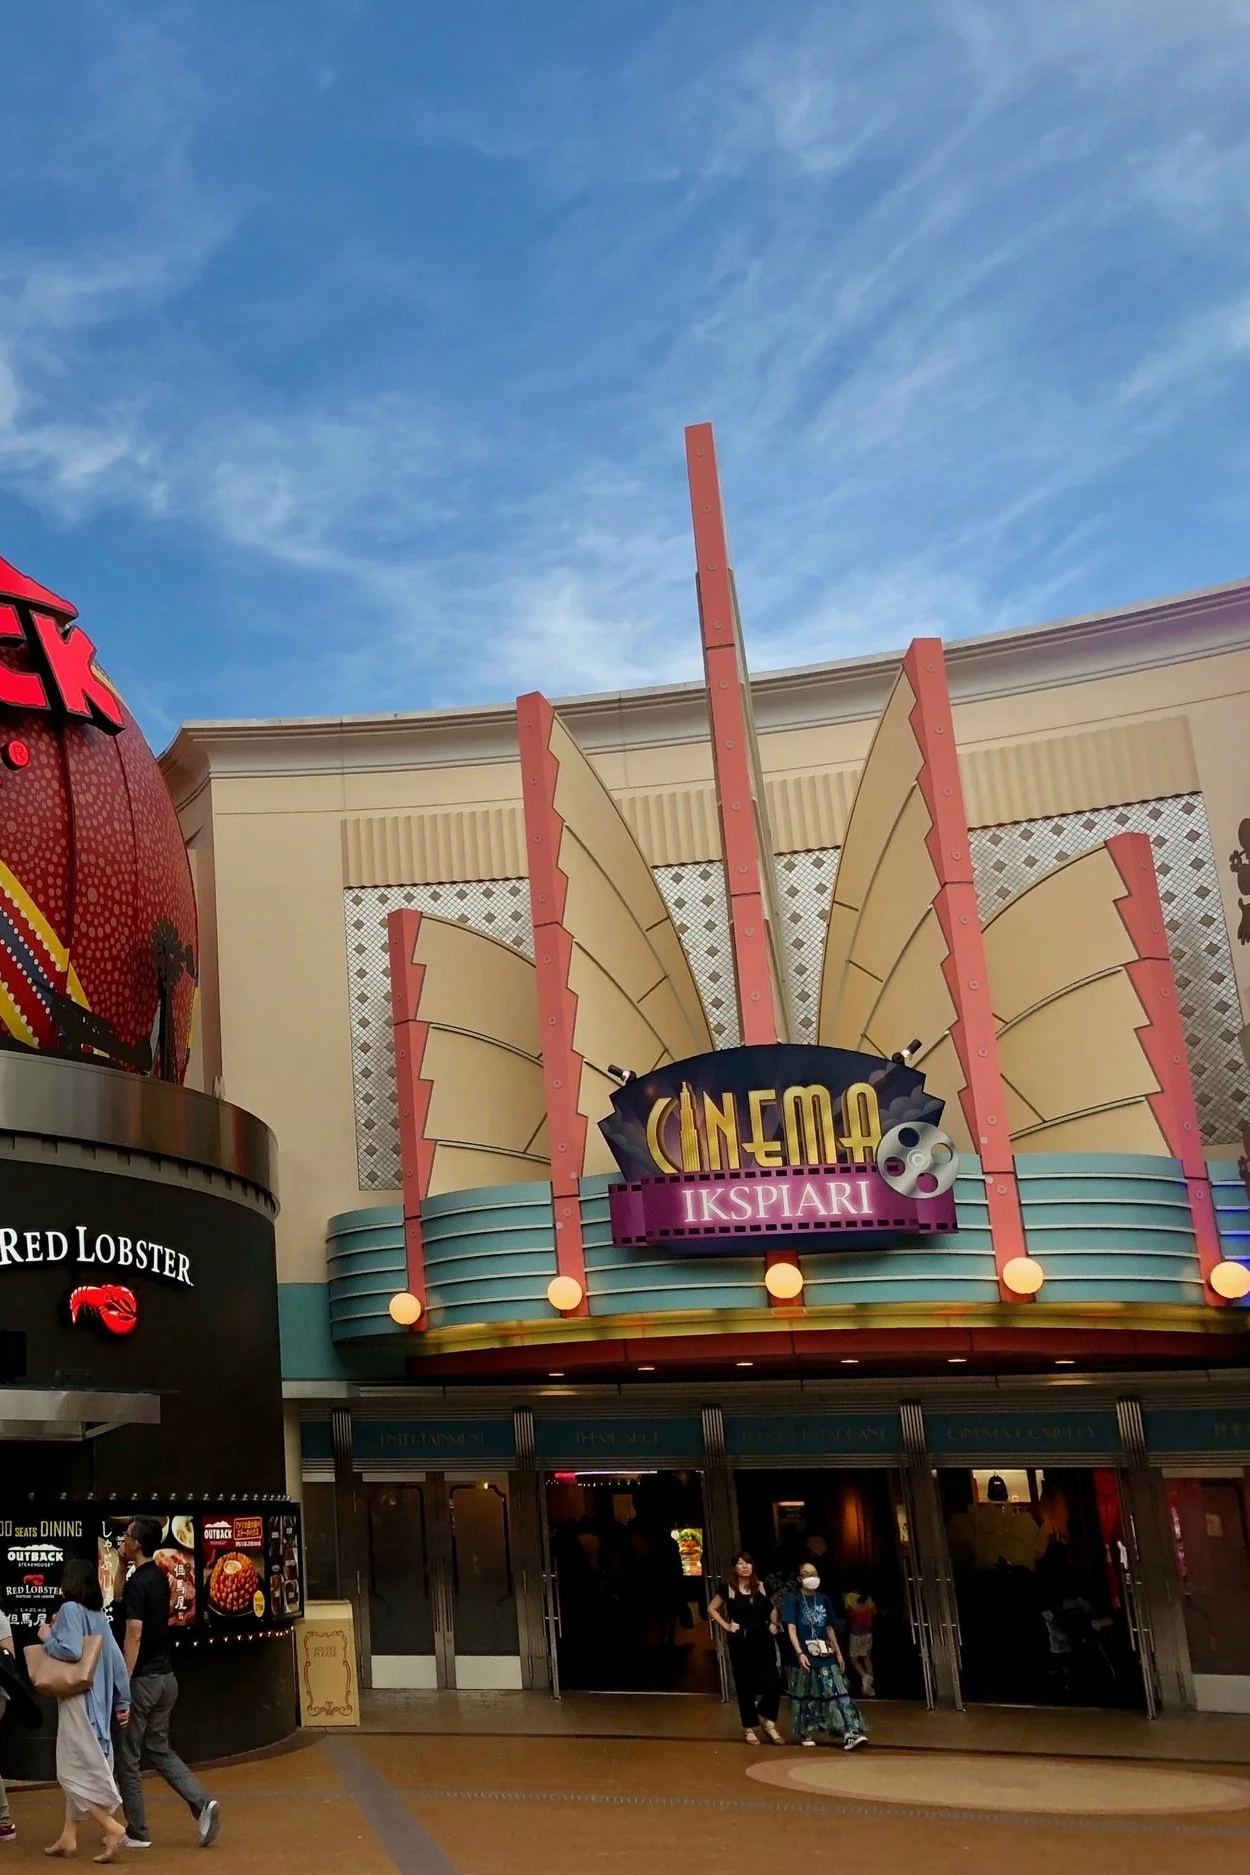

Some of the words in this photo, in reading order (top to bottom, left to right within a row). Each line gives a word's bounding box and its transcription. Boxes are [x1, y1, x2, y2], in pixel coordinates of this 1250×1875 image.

[646, 1081, 883, 1174] CINEMA
[681, 1181, 874, 1222] IKSPIARI
[75, 1226, 195, 1288] LOBSTER
[14, 1526, 38, 1538] SEATS
[40, 1520, 82, 1538] DINING
[204, 1528, 232, 1540] OUTBACK
[7, 1551, 64, 1562] OUTBACK
[6, 1586, 24, 1596] RED
[174, 1564, 187, 1610] 但馬屋
